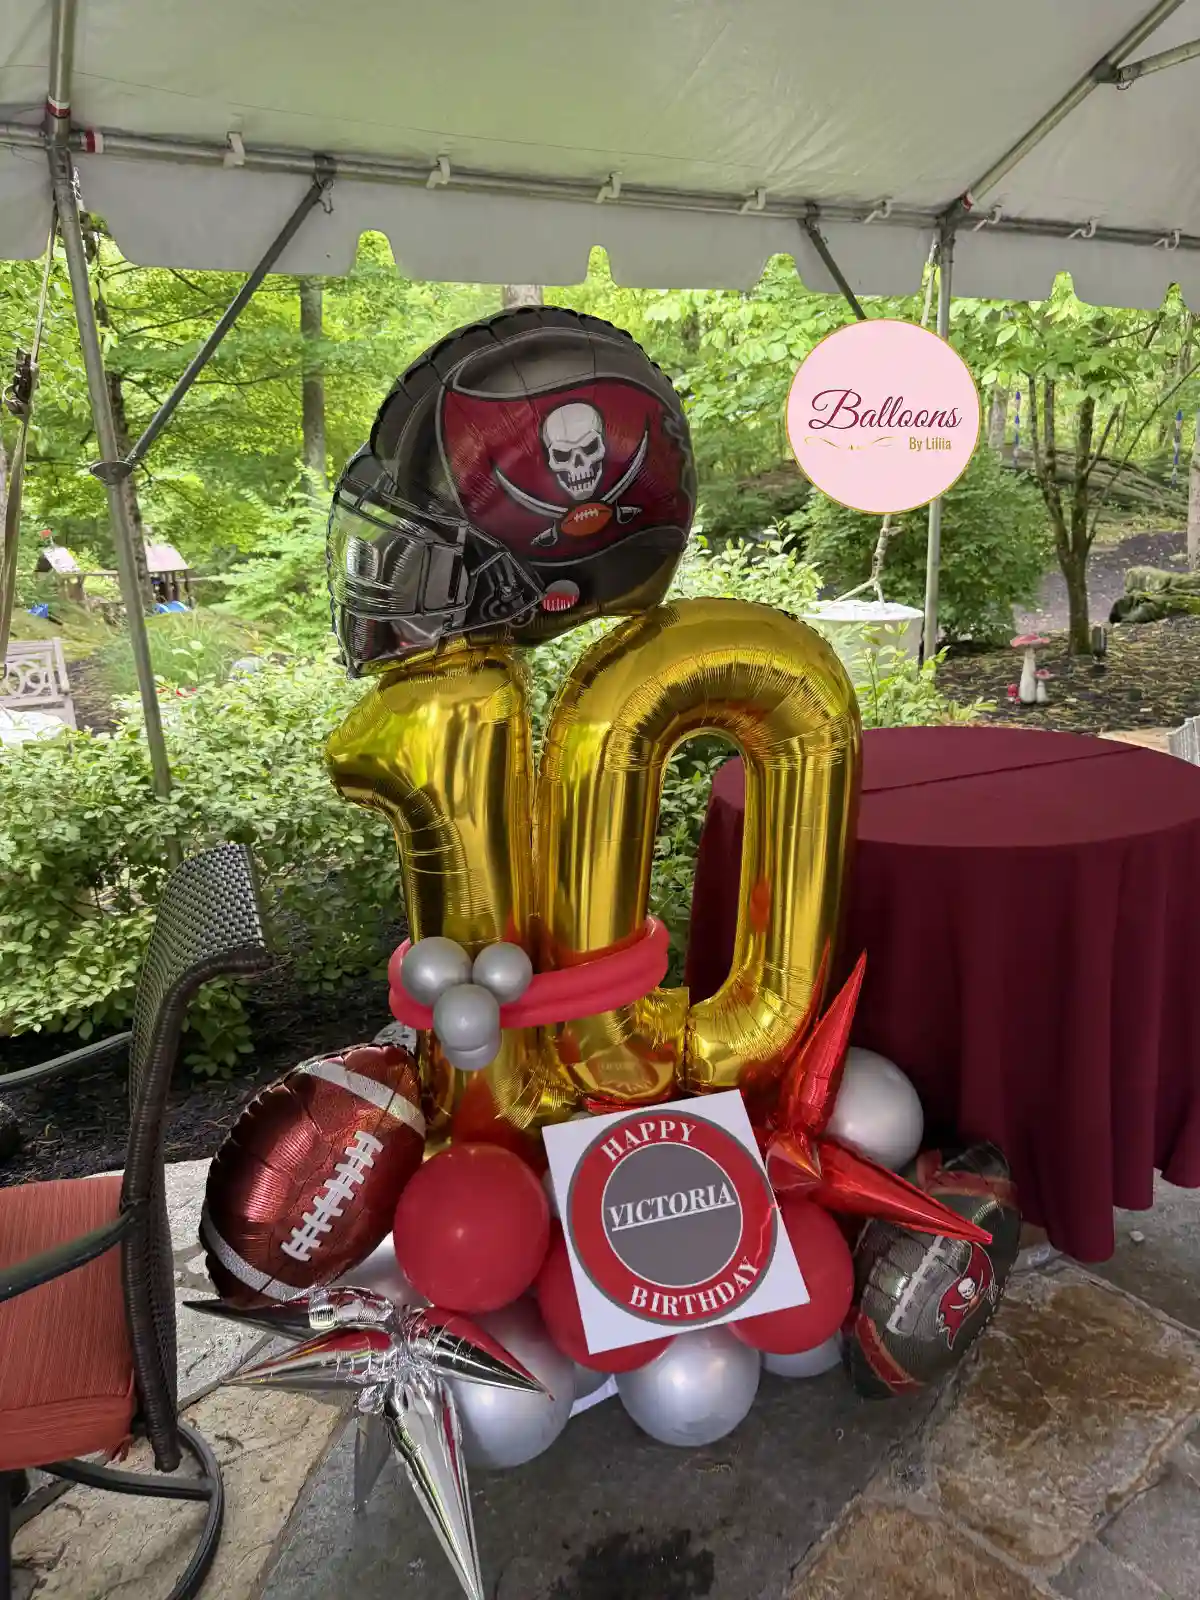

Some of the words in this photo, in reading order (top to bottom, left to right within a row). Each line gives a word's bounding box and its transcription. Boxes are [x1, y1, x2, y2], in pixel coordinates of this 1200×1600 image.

[601, 1120, 696, 1162] HAPPY
[608, 1181, 736, 1230] VICTORIA
[629, 1256, 759, 1316] BIRTHDAY
